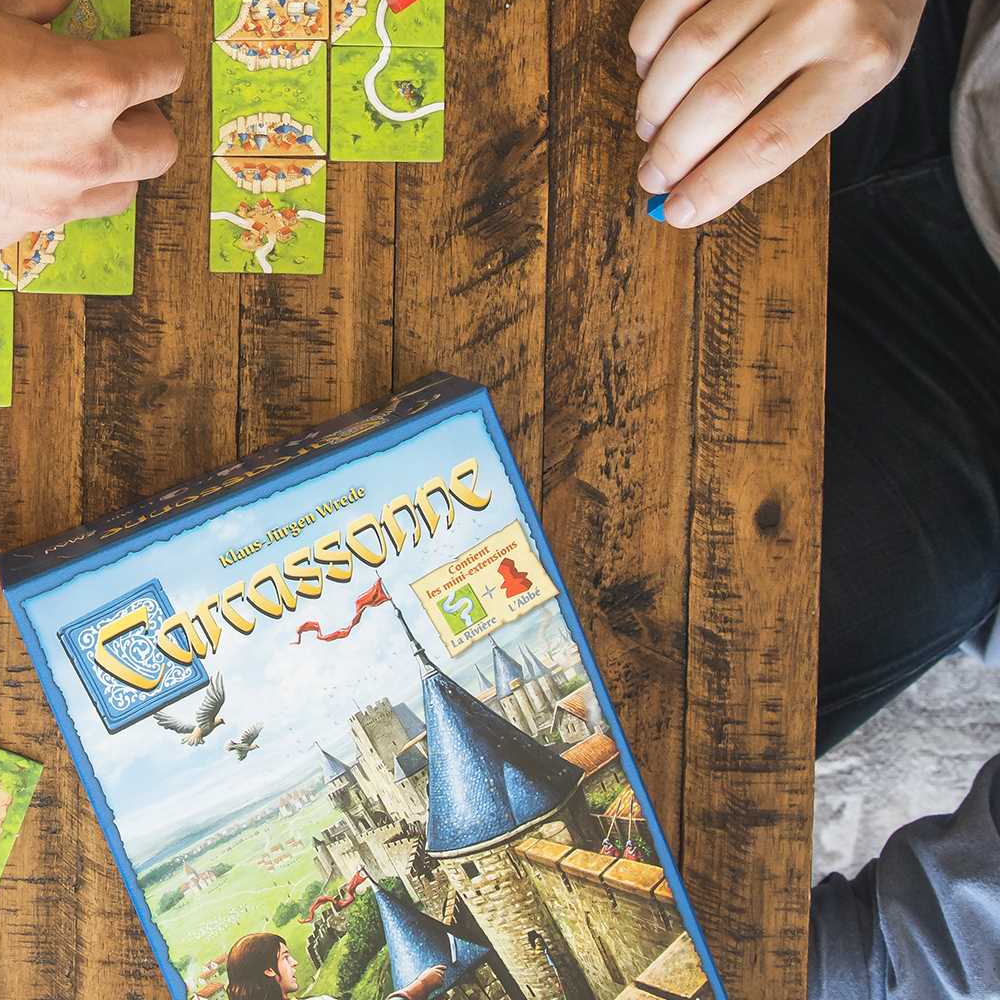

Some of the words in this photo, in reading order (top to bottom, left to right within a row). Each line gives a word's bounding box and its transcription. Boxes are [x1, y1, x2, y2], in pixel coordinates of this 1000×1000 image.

[218, 511, 316, 568] Klaus-Jürgen
[316, 486, 366, 519] Wrede
[94, 457, 492, 692] Carcassonne
[426, 587, 442, 600] les
[443, 540, 518, 590] mini-extensions
[448, 544, 491, 574] Contient
[450, 636, 463, 649] La
[464, 615, 498, 642] Rivière
